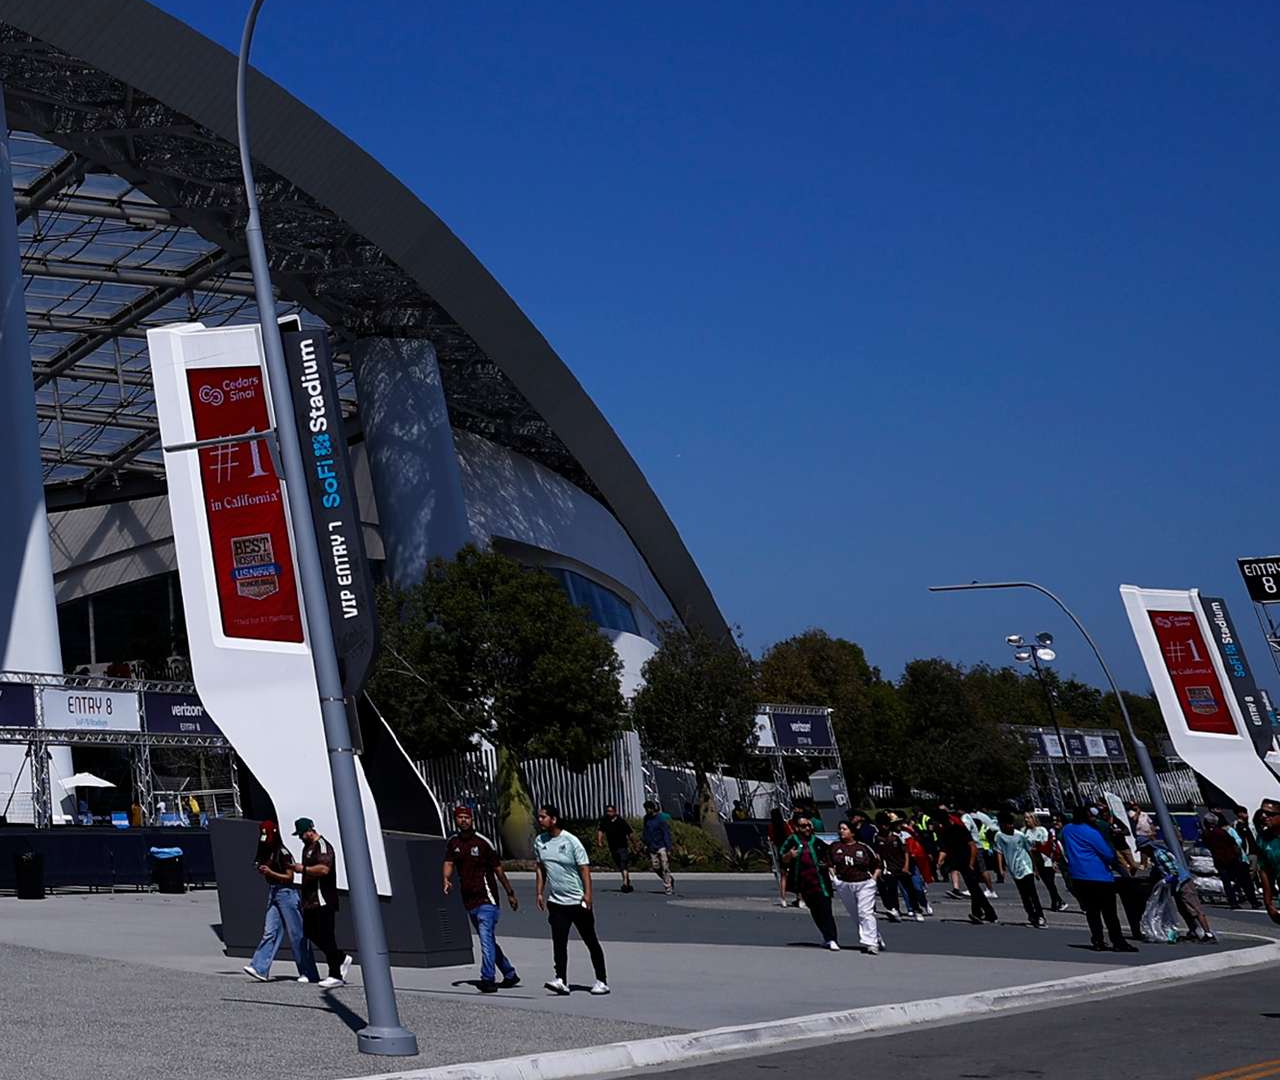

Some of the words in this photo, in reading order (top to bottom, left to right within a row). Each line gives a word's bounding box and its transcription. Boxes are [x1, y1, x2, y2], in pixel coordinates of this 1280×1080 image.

[222, 376, 259, 391] Cedars
[230, 387, 255, 402] Sinai
[299, 338, 328, 433] Stadium
[209, 426, 270, 484] #1
[316, 460, 341, 508] SoFi
[210, 499, 222, 511] in
[223, 491, 278, 509] California
[233, 537, 269, 556] BEST
[330, 535, 353, 586] ENTRY
[1262, 576, 1277, 593] 8
[340, 590, 359, 619] VIP
[1211, 602, 1233, 644] Stadium
[1165, 638, 1204, 663] #1
[68, 696, 102, 714] ENTRY
[105, 697, 113, 715] 8
[171, 702, 202, 716] verizon
